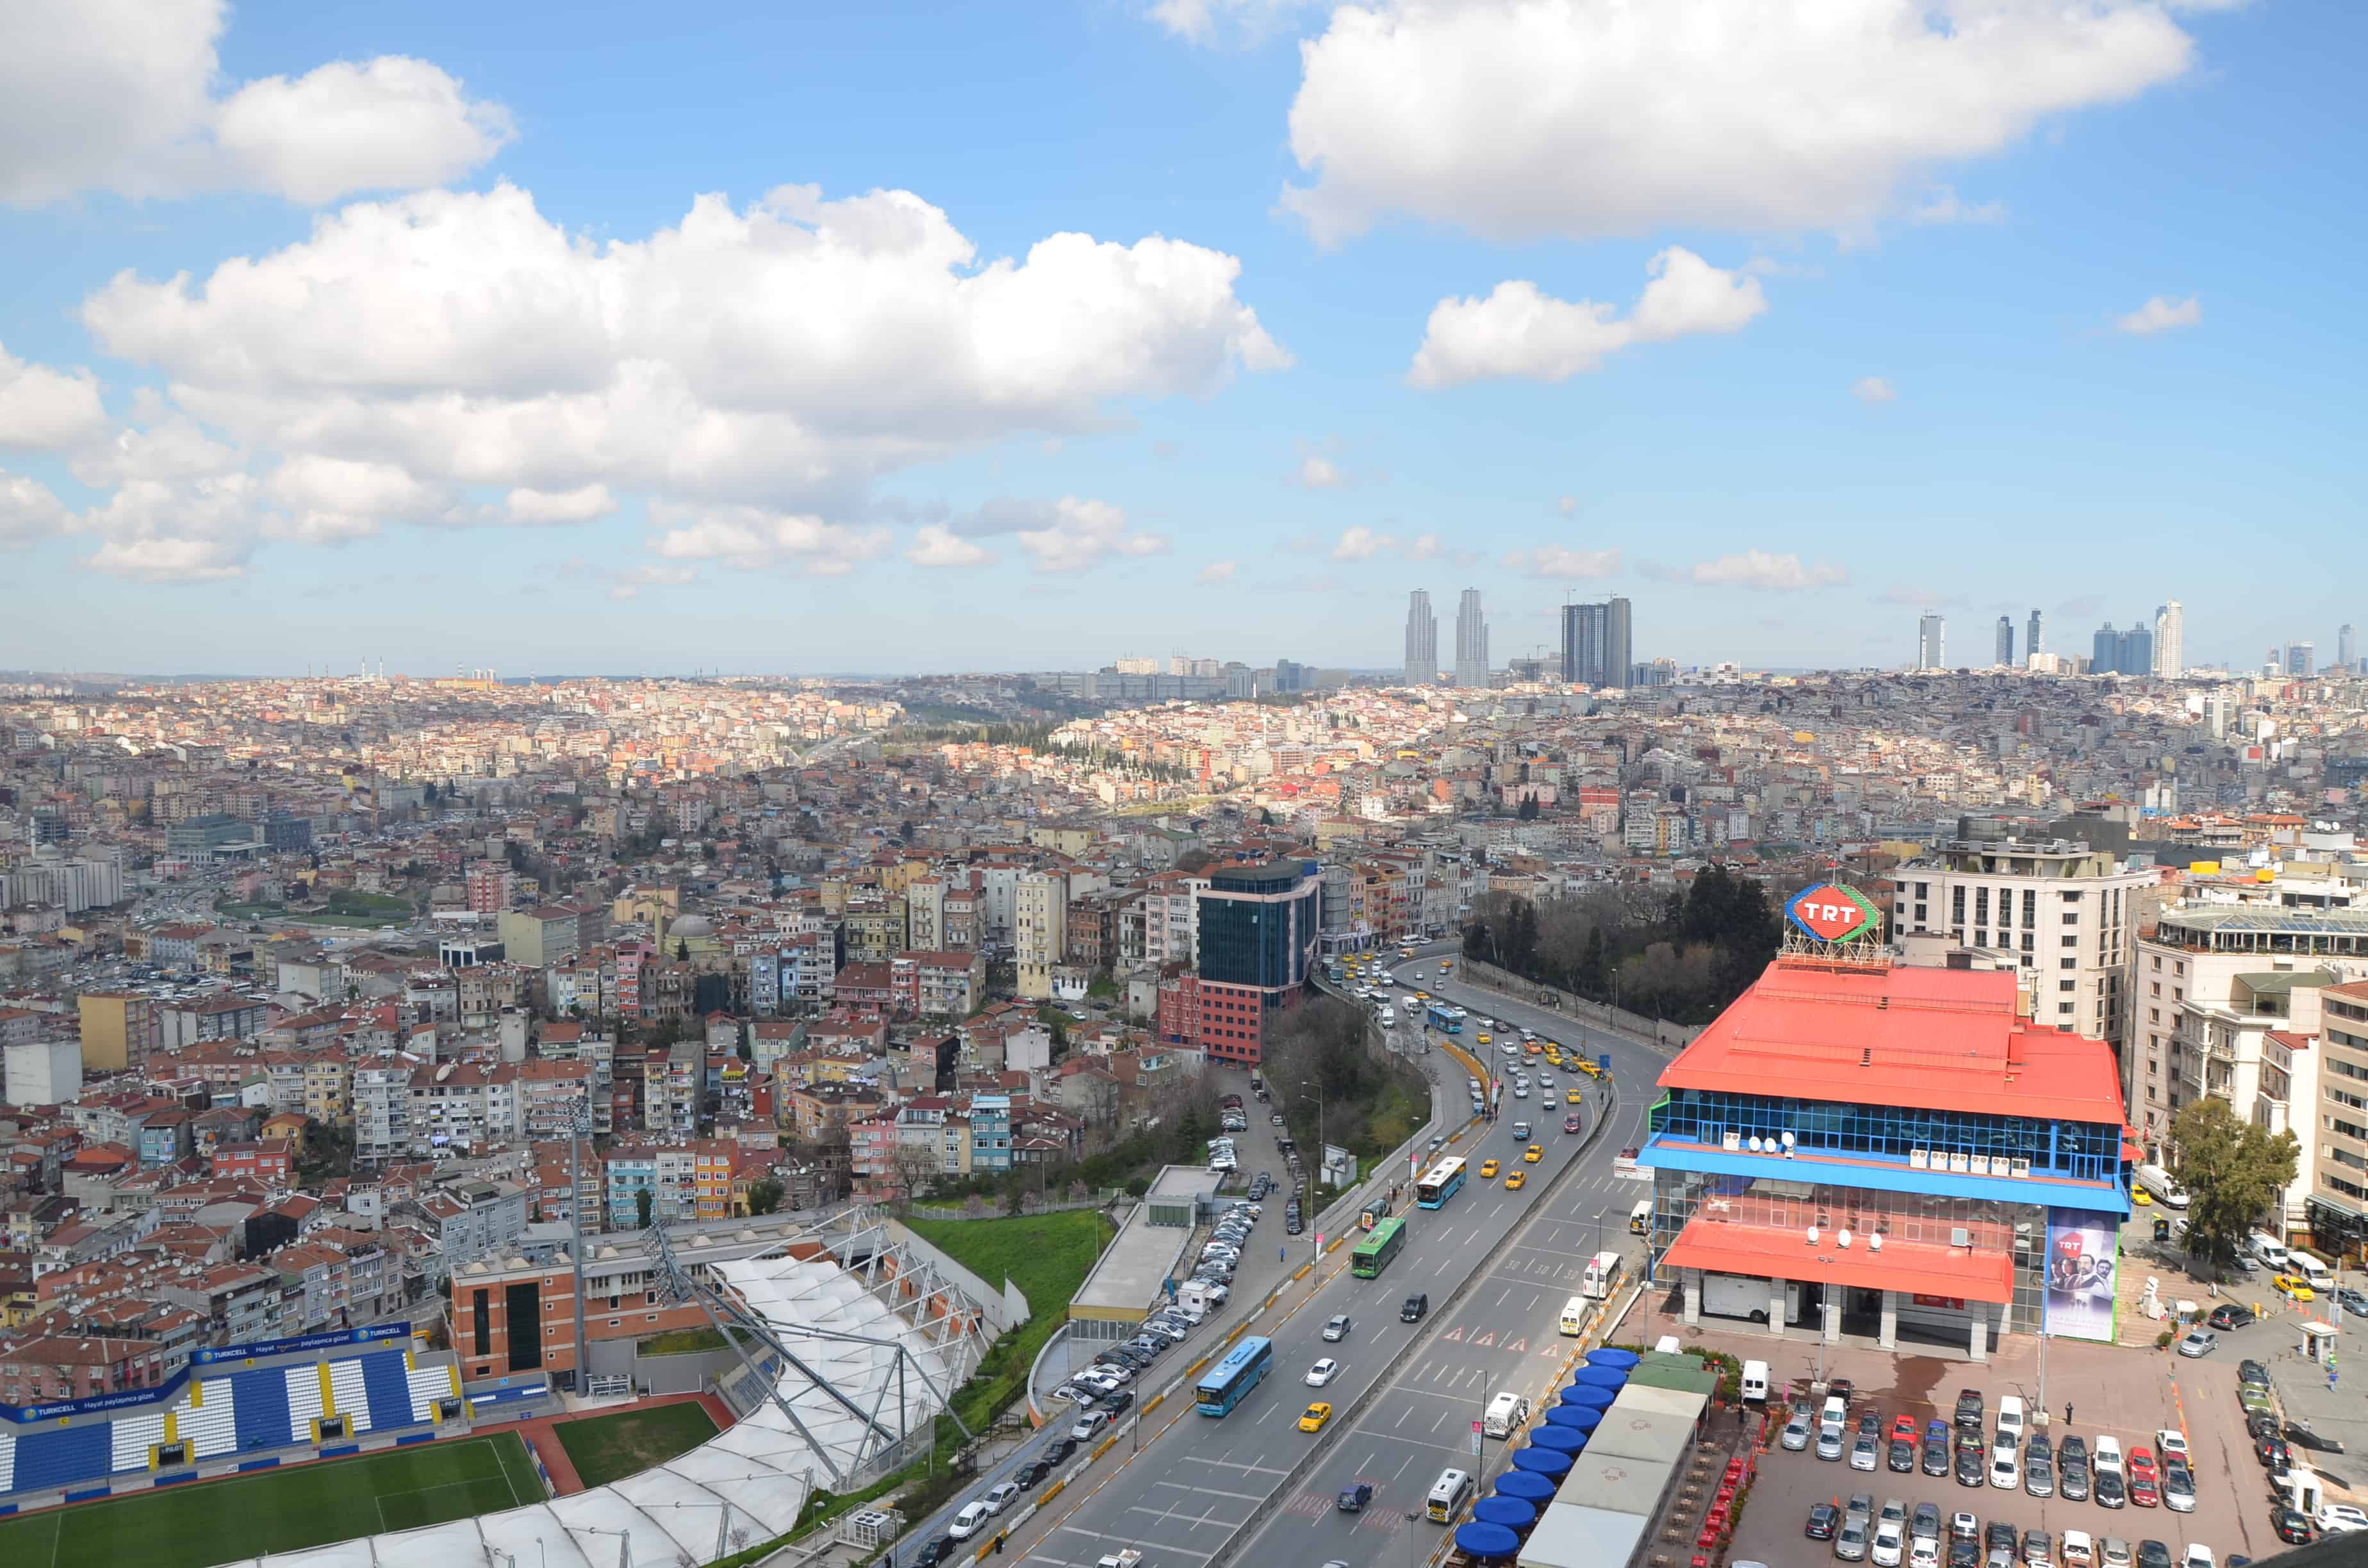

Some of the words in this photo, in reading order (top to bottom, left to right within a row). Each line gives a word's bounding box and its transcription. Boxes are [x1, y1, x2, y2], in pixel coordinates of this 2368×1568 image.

[1804, 902, 1856, 924] TRT
[2059, 1241, 2081, 1251] TRT
[370, 1327, 401, 1337] TURKCELL
[214, 1348, 247, 1359] TURKCELL
[256, 1344, 274, 1353] Hayat
[84, 1400, 103, 1409] Hayat
[38, 1404, 76, 1416] TURKCELL
